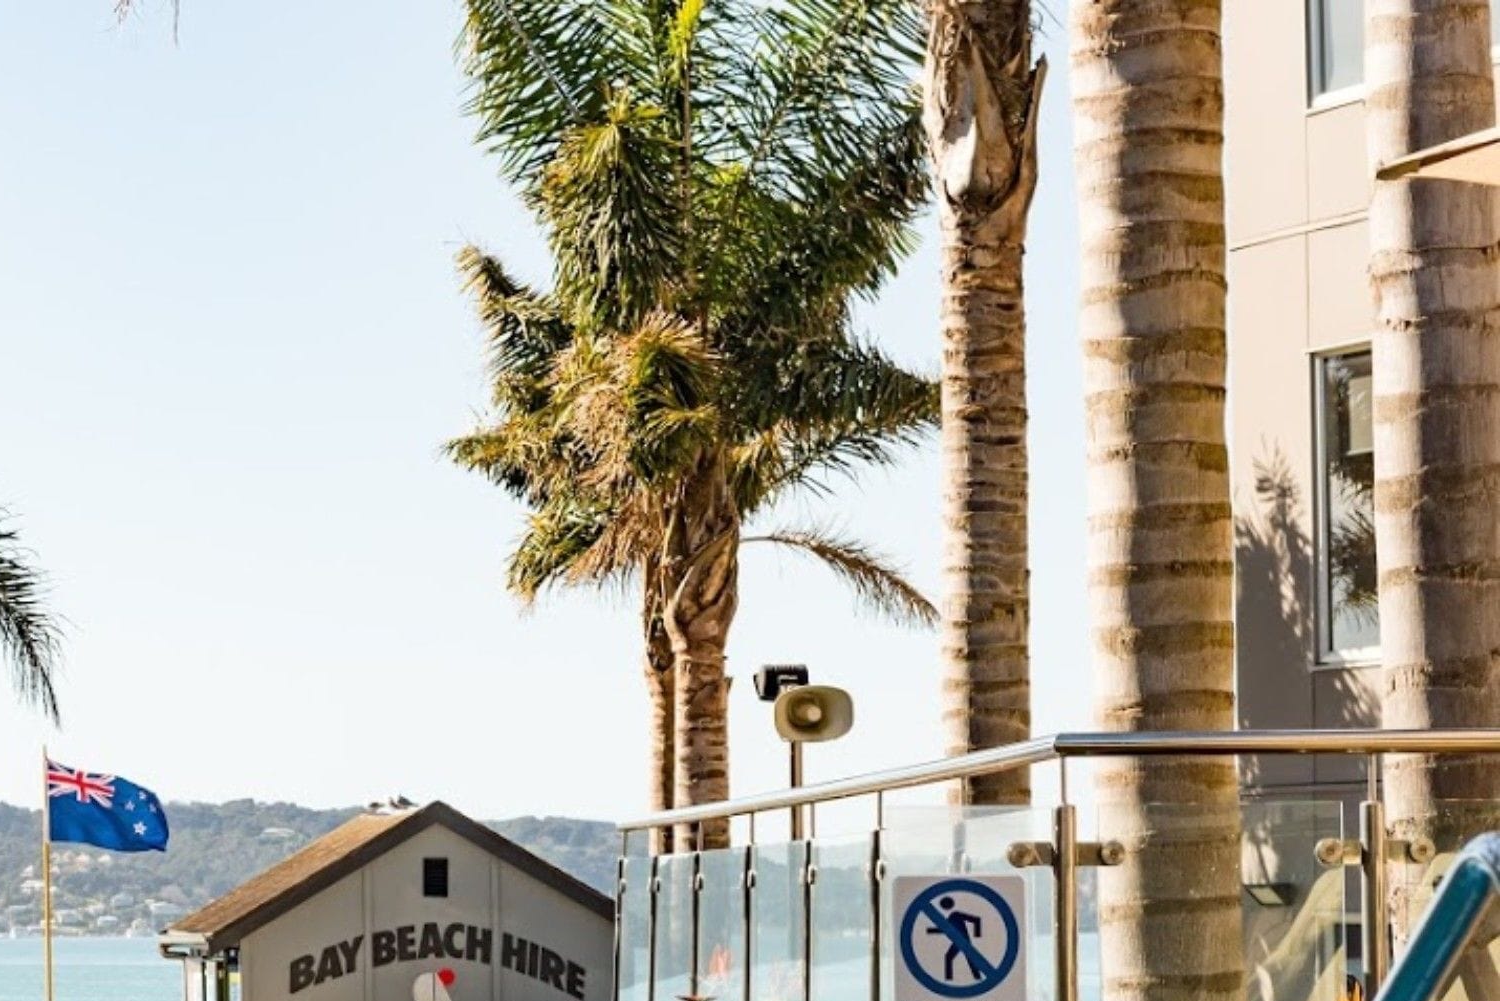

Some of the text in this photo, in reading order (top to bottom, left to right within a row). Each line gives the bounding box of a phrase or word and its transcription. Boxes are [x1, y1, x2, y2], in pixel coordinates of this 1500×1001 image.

[289, 922, 587, 1001] BAY BEACH HIRE
